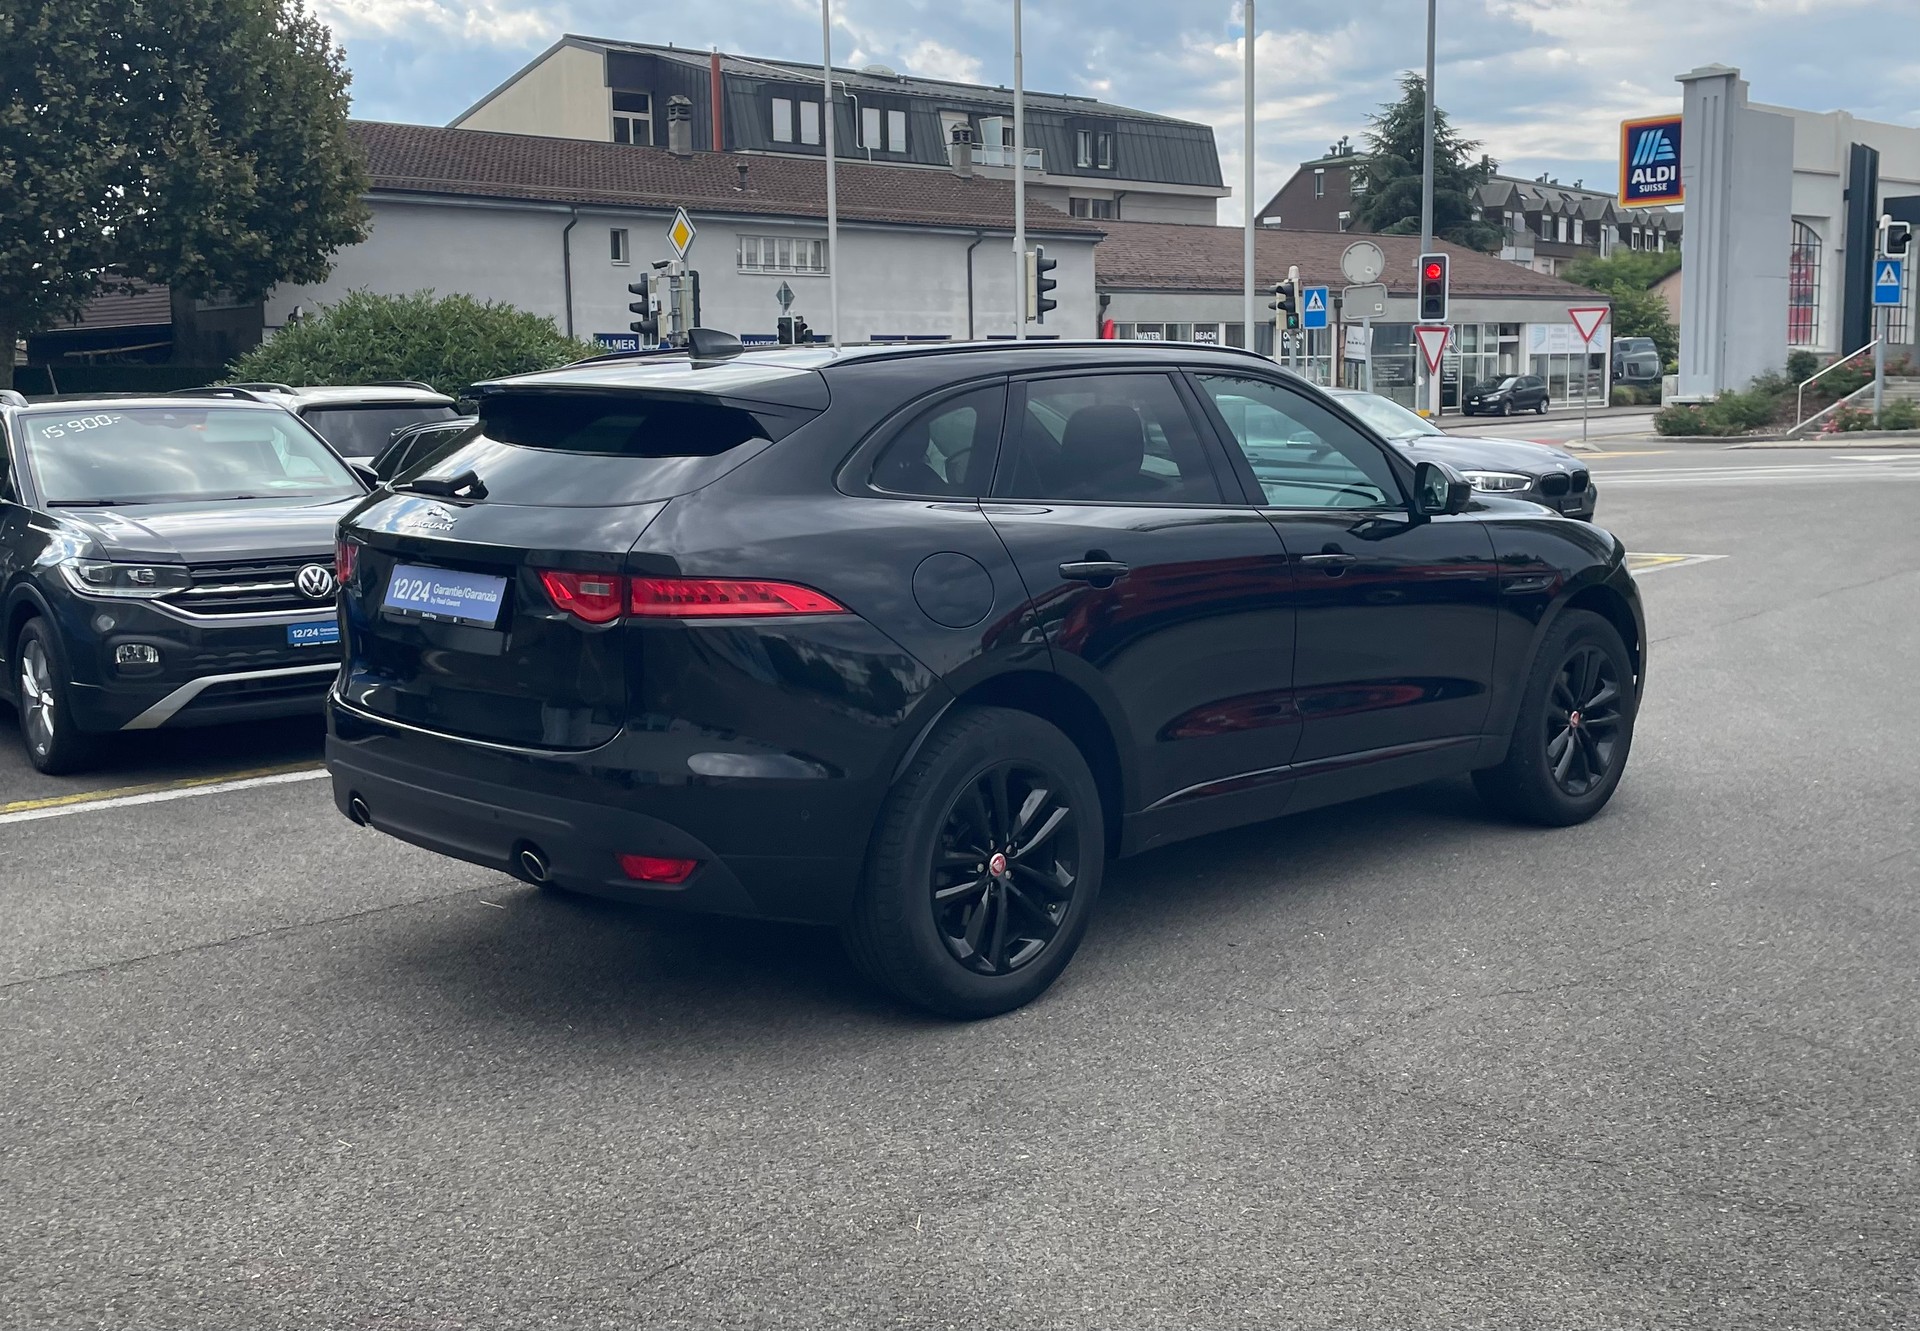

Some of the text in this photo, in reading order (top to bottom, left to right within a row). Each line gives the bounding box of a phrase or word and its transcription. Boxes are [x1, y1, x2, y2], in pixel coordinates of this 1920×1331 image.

[1631, 165, 1676, 184] ALDI
[1639, 183, 1667, 193] SUISSE
[1137, 331, 1160, 340] WATER
[1195, 331, 1217, 340] BEACH
[408, 520, 453, 531] JAGUAR
[393, 578, 497, 602] 12/24 Garantie/Garanzia
[292, 628, 319, 638] 12/24
